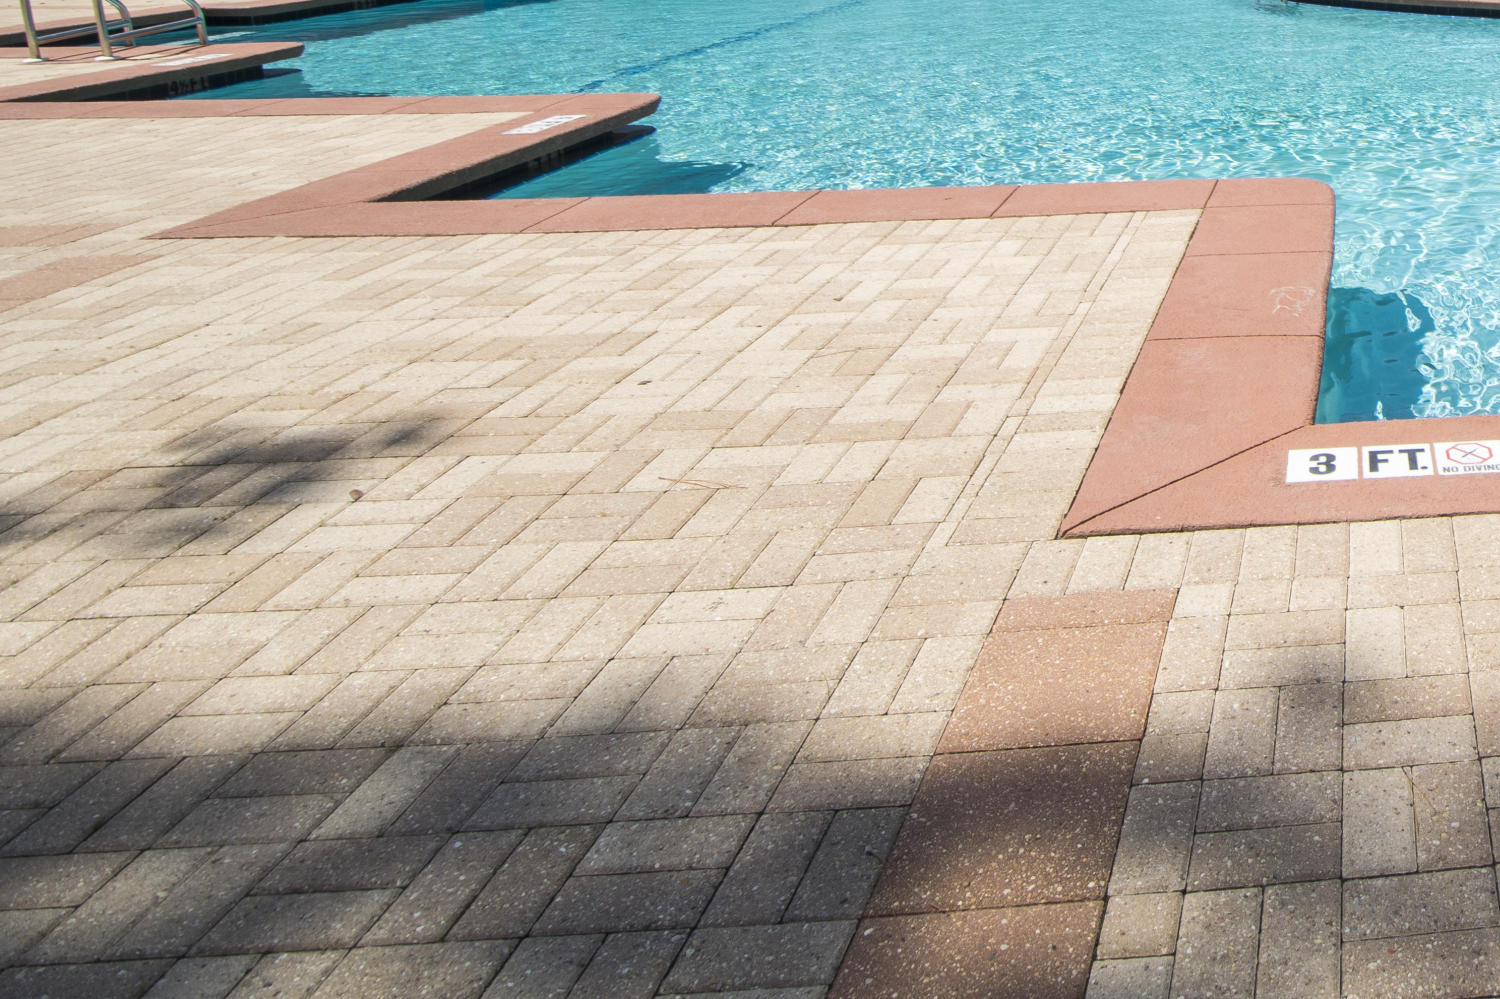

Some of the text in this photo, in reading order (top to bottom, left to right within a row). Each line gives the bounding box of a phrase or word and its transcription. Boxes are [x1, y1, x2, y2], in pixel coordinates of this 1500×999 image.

[1308, 448, 1429, 475] 3 FT.
[1442, 465, 1459, 473] NO
